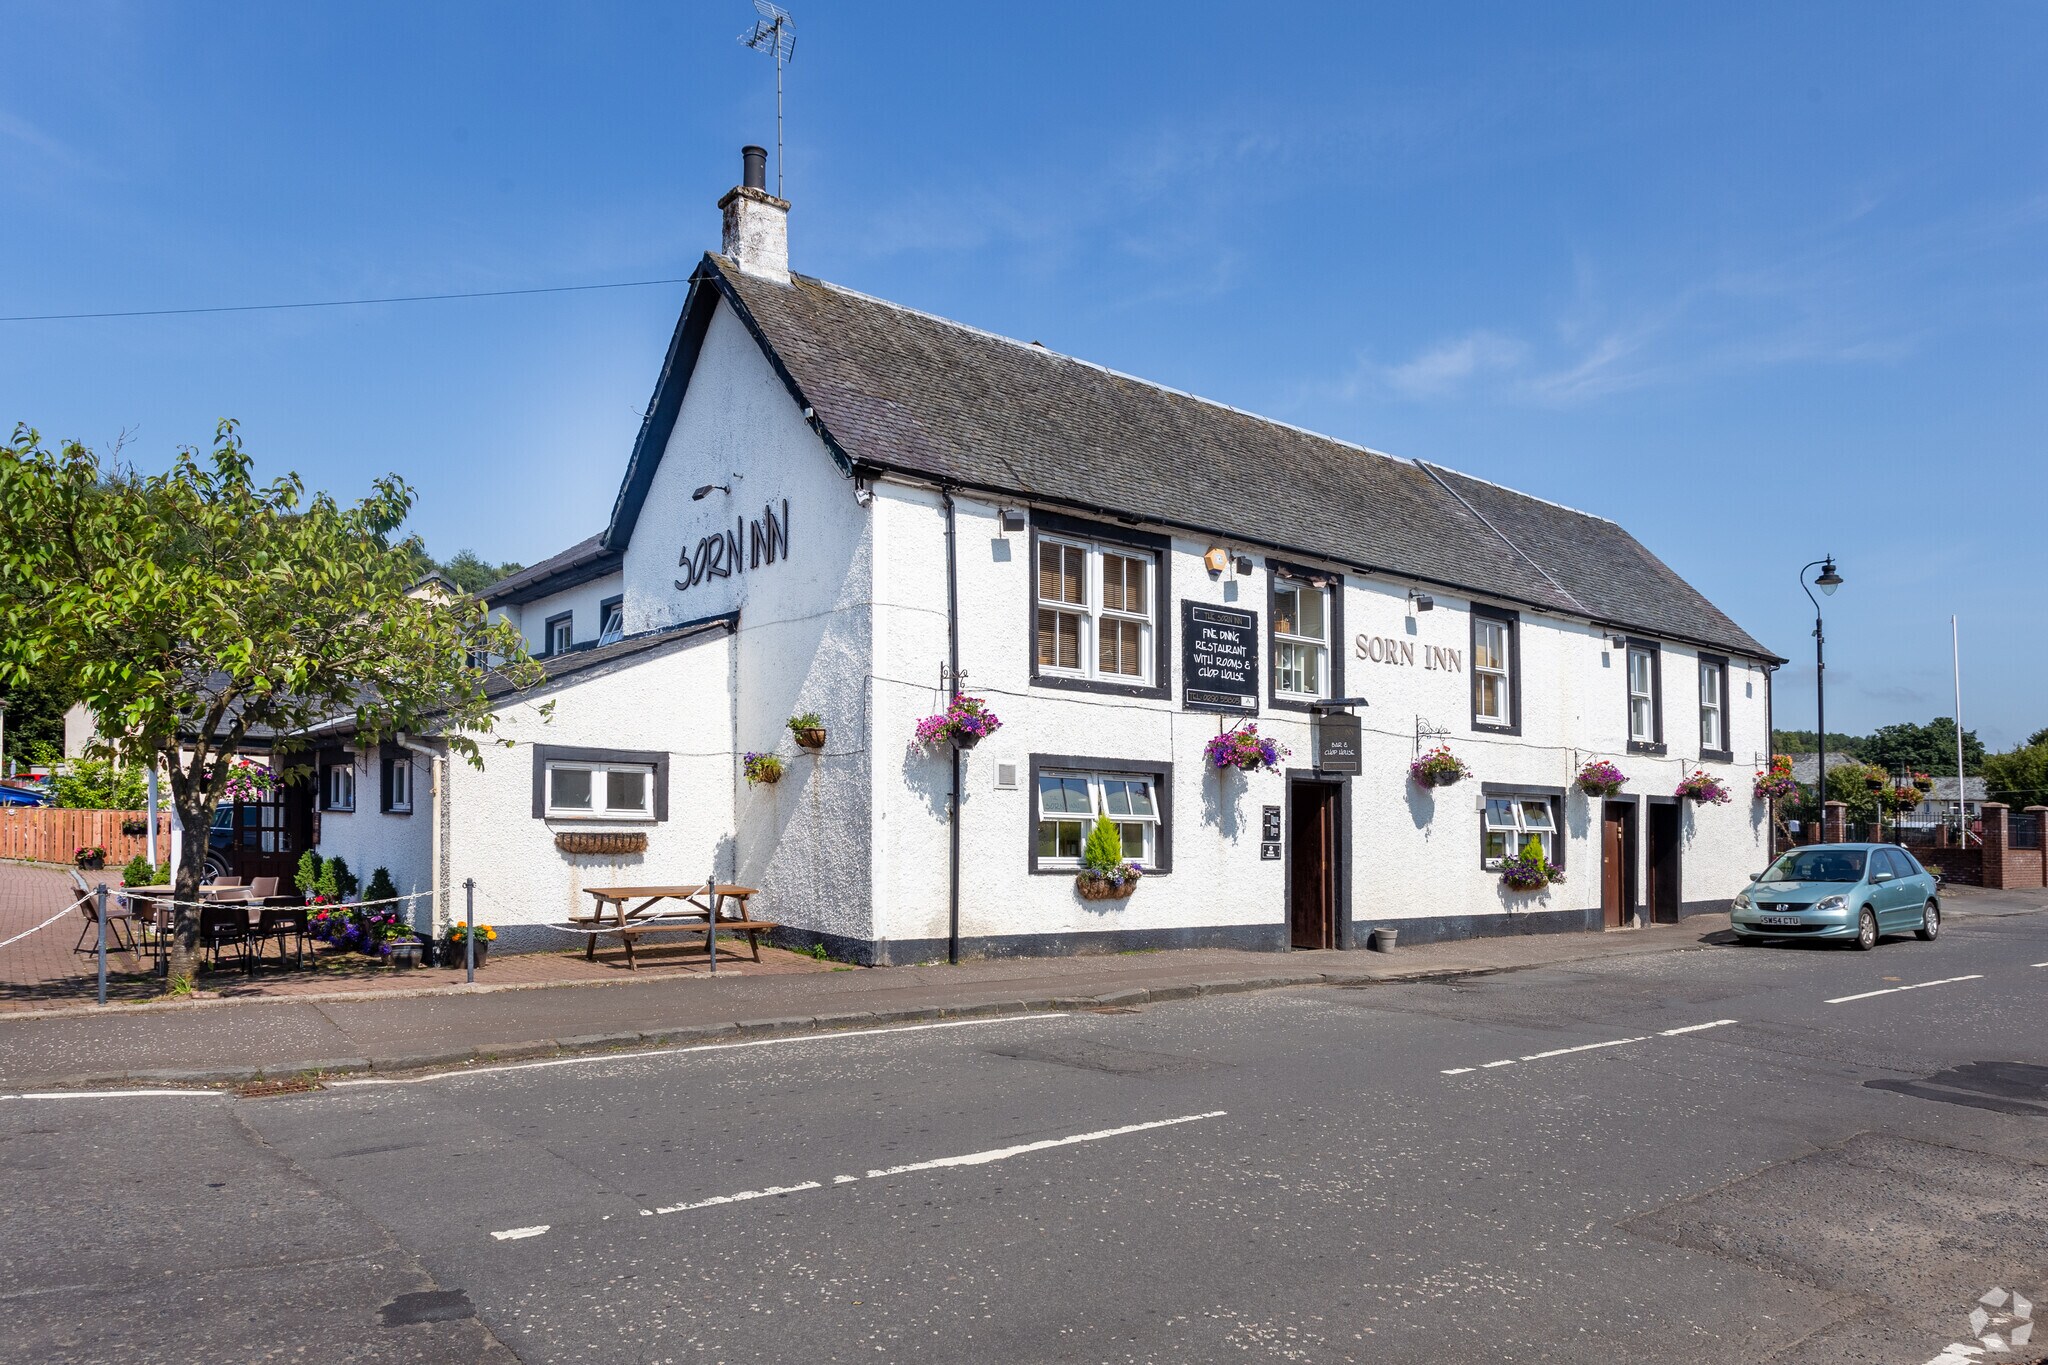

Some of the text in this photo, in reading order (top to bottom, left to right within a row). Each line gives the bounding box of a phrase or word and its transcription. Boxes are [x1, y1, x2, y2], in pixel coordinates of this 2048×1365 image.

[674, 498, 788, 591] SORN INN
[1217, 614, 1232, 624] SORN
[1195, 640, 1247, 657] RESTAURANT
[1355, 633, 1462, 673] SORN INN
[1193, 652, 1251, 670] WITH ROOMS &
[1198, 666, 1245, 682] CHOP HOUSE
[1338, 748, 1355, 756] HOUSE
